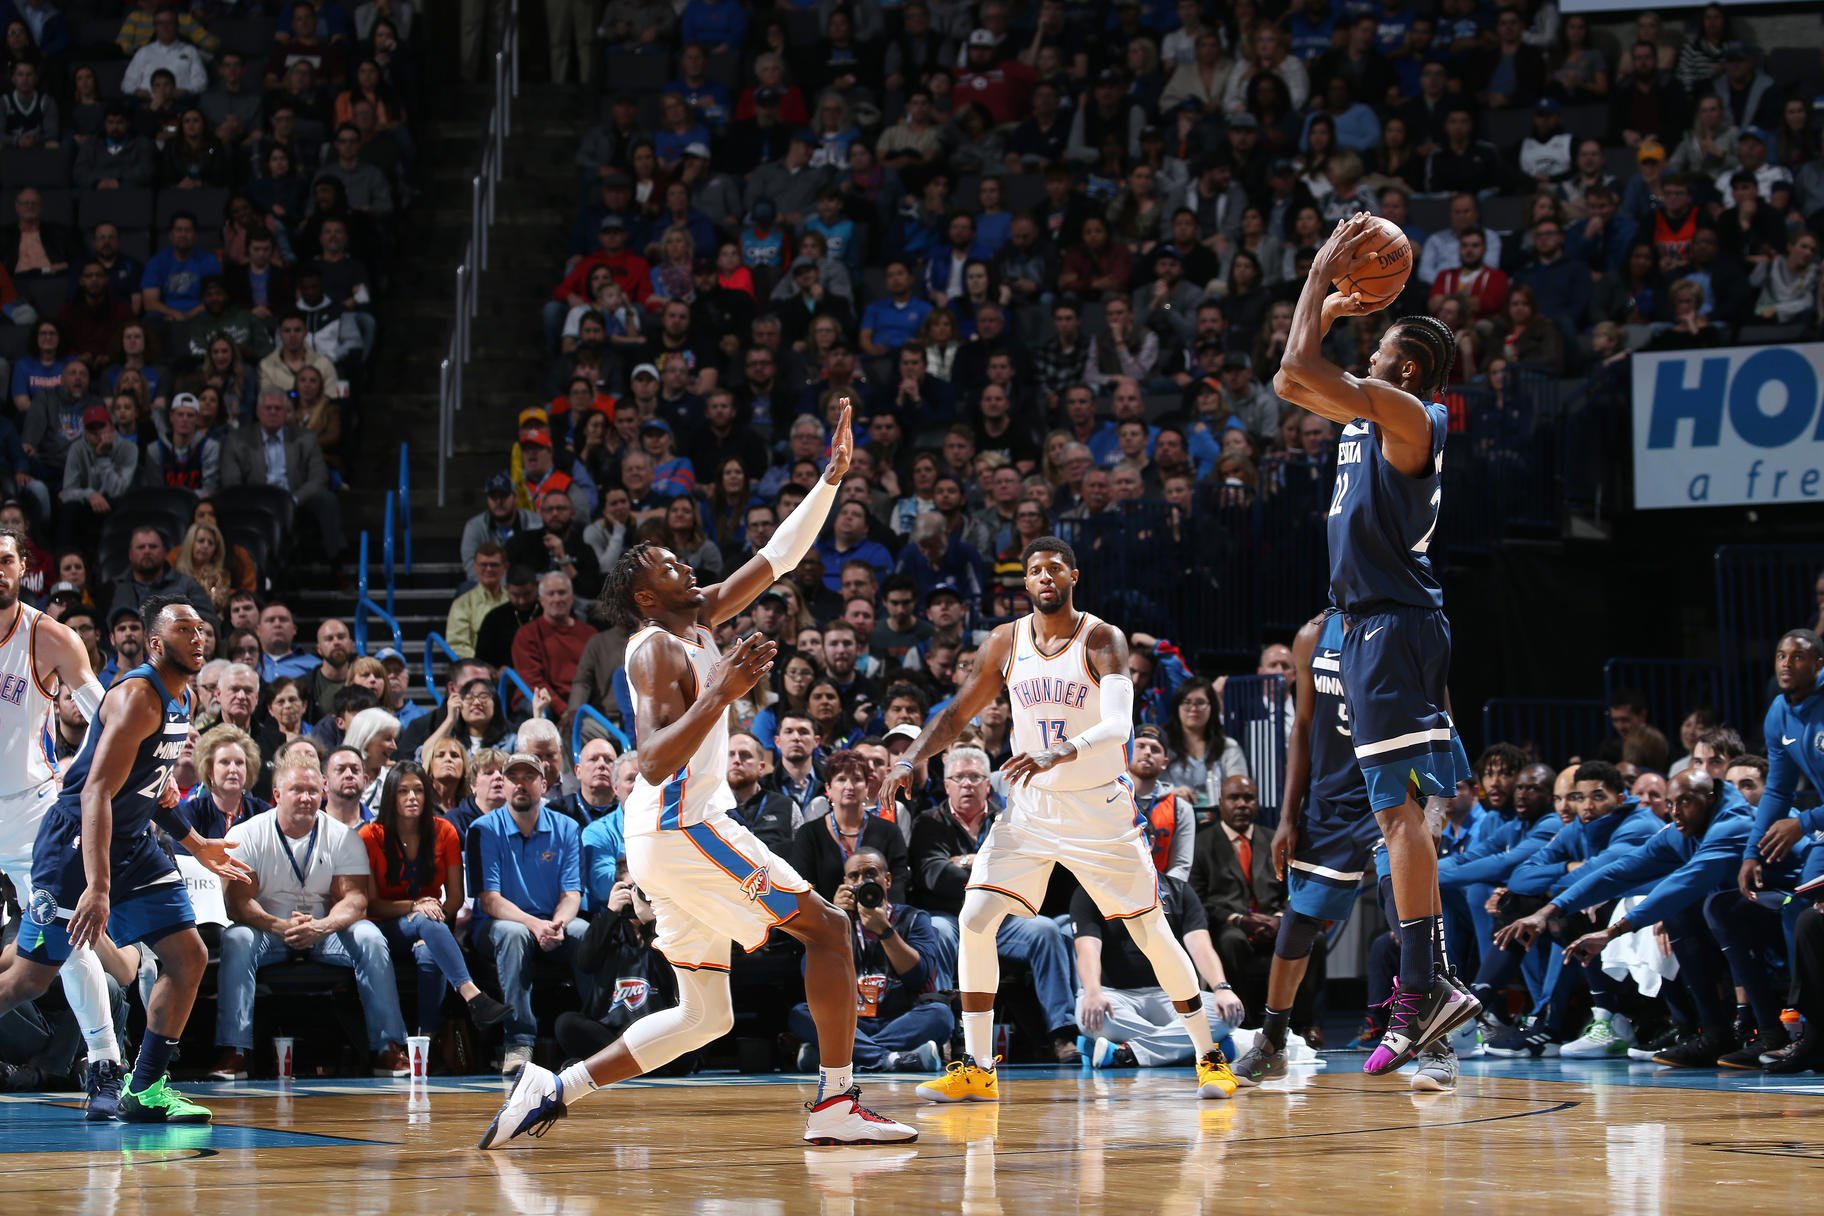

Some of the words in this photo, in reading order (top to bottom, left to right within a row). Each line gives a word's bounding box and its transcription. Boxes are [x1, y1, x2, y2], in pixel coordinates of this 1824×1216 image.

[1647, 347, 1824, 449] HO
[1688, 473, 1710, 501] a
[1747, 459, 1820, 498] fre
[0, 671, 28, 705] ER
[1012, 677, 1089, 709] THUNDER
[1036, 719, 1068, 751] 13
[1336, 703, 1351, 736] 5
[185, 877, 216, 890] FIRS
[748, 871, 764, 902] OKC
[613, 984, 645, 1002] OKC
